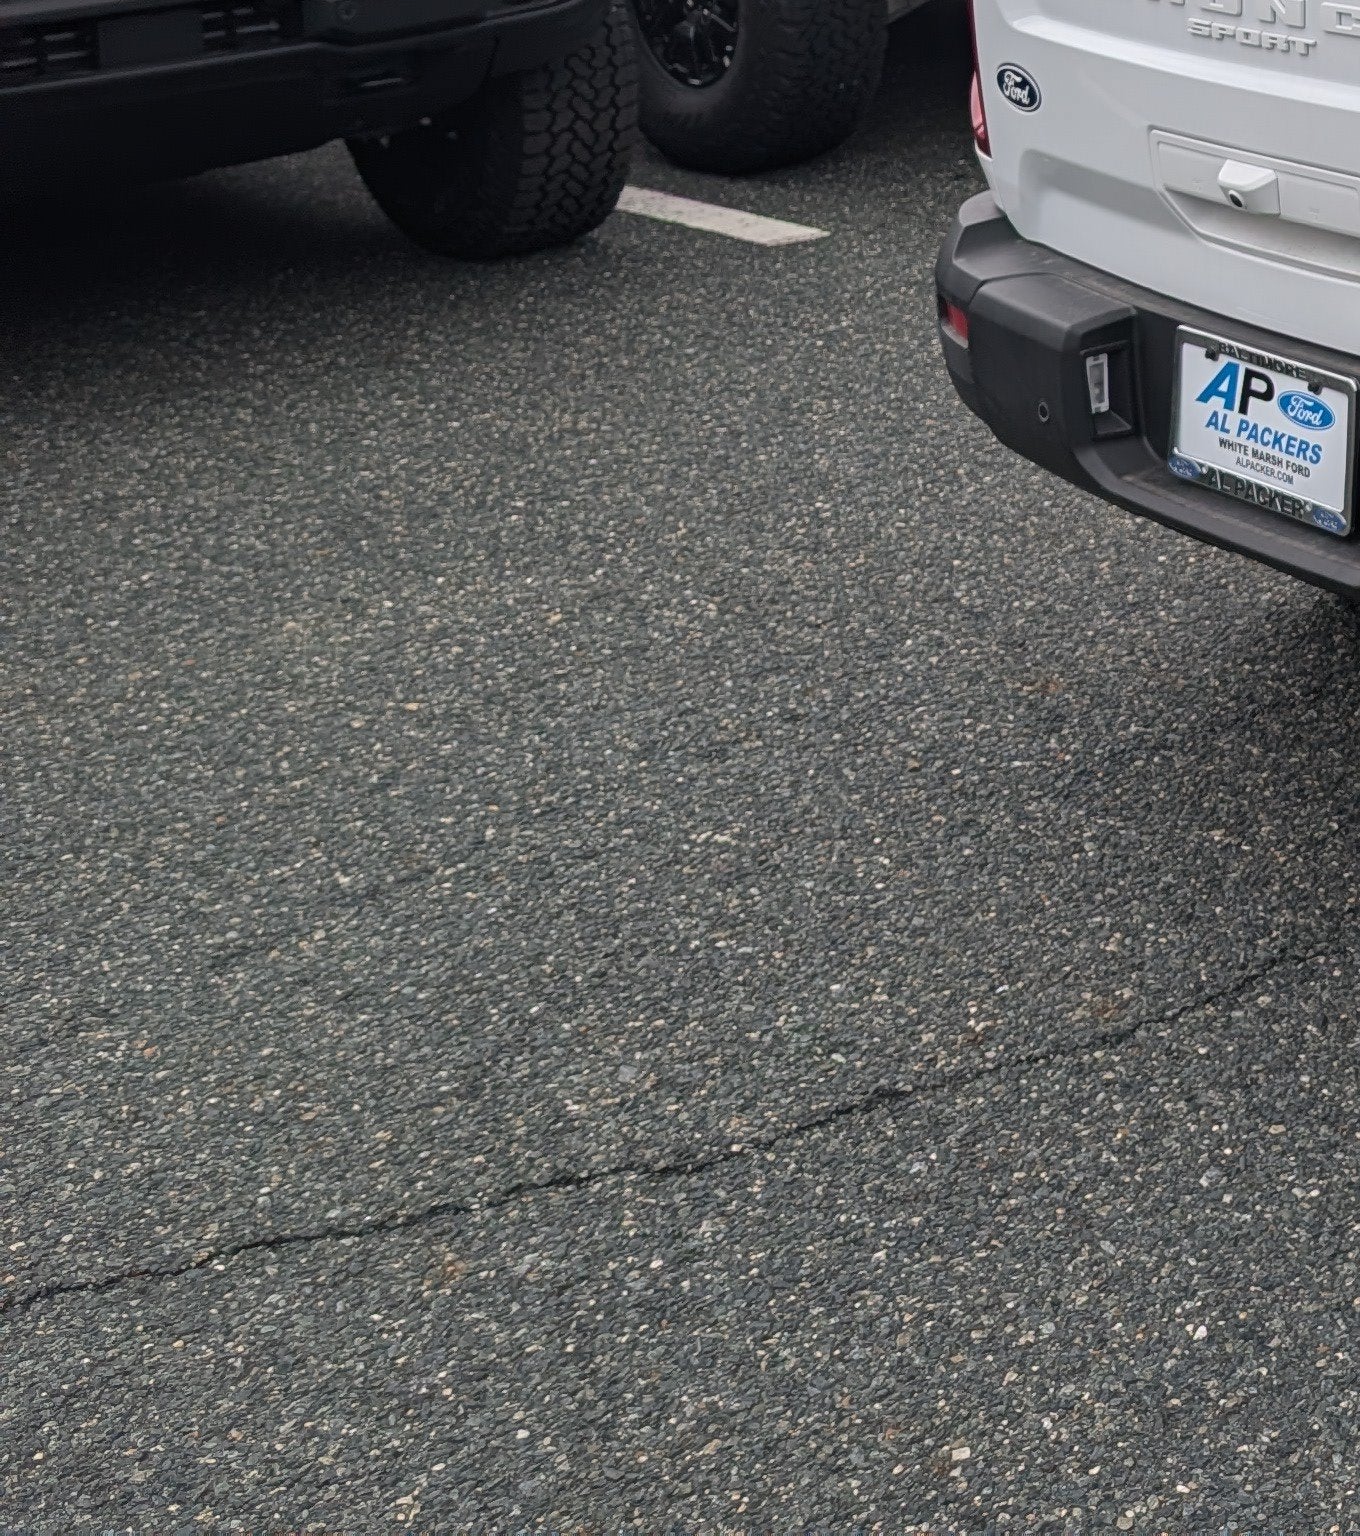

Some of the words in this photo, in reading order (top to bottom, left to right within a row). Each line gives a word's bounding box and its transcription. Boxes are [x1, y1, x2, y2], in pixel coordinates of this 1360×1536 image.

[1186, 17, 1318, 56] SPORT
[1194, 361, 1276, 416] AP
[1205, 410, 1231, 435] AL
[1236, 418, 1324, 465] PACKERS
[1218, 436, 1250, 457] WHITE
[1251, 448, 1283, 470] MARSH
[1285, 459, 1311, 479] FORD
[1208, 468, 1232, 492] AL
[1235, 456, 1295, 486] ALPACKER.COM
